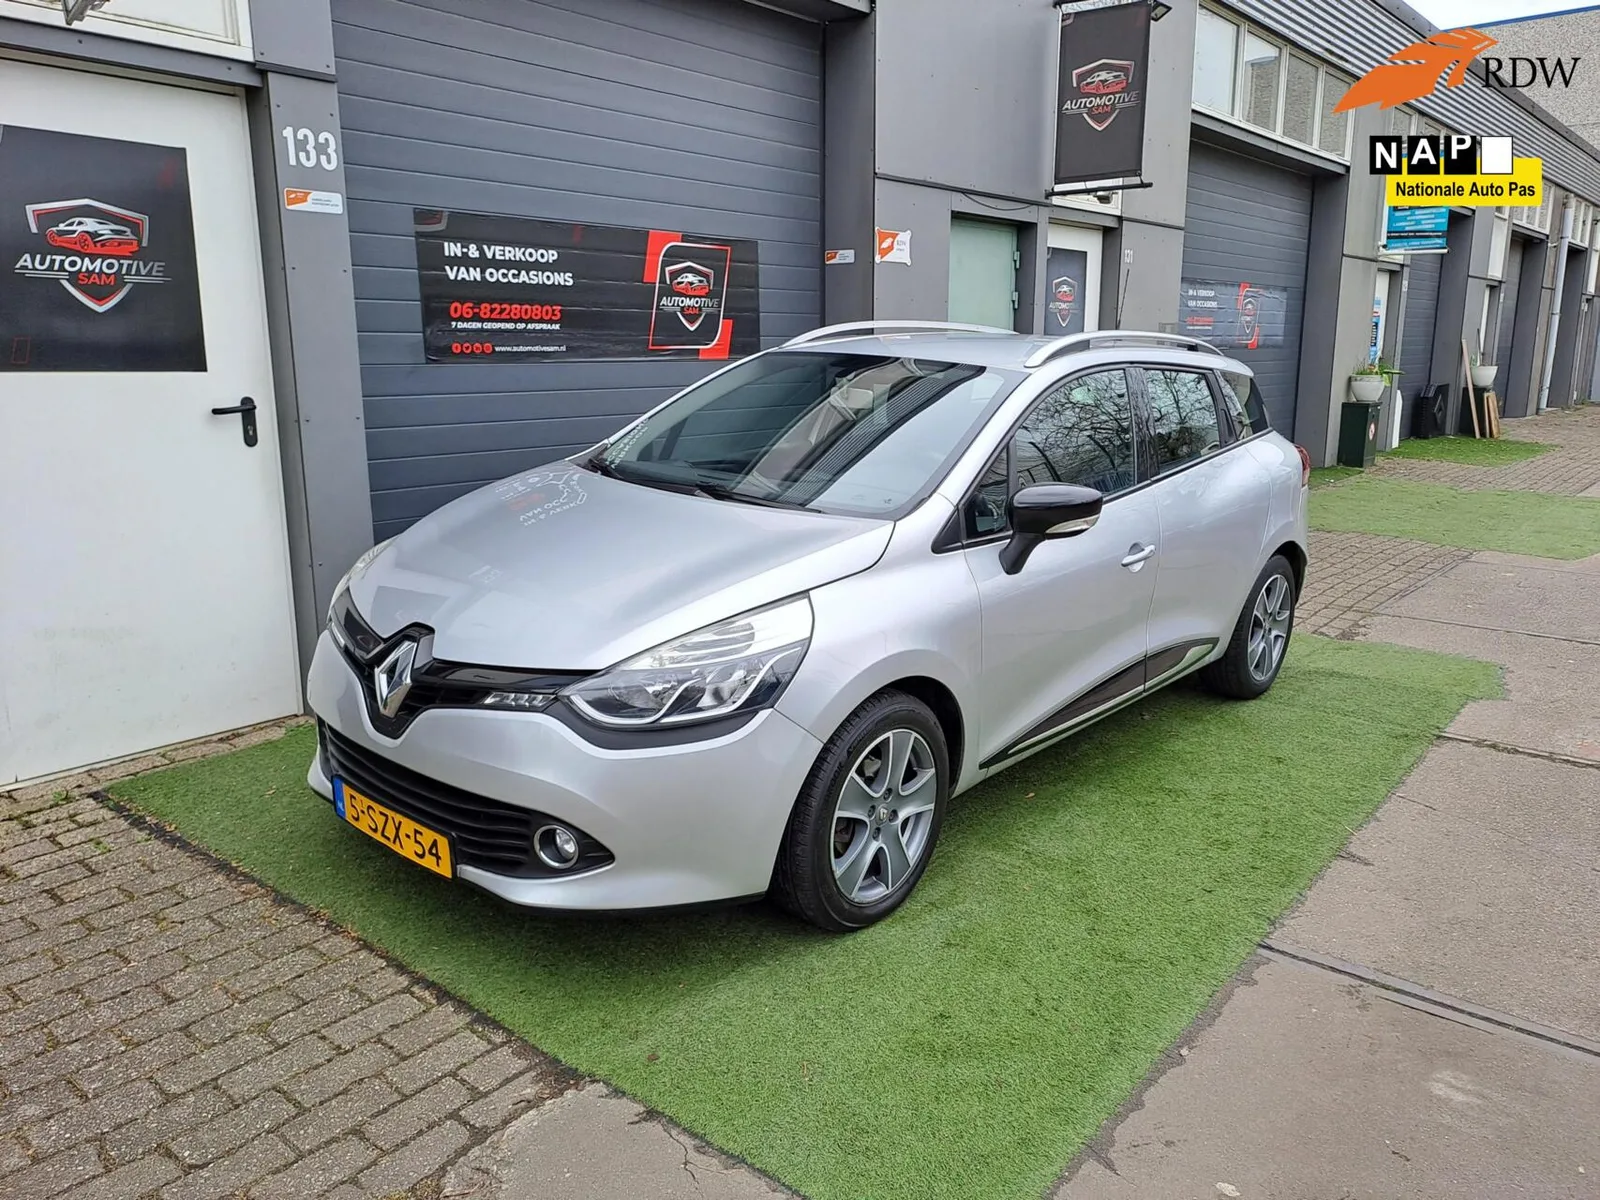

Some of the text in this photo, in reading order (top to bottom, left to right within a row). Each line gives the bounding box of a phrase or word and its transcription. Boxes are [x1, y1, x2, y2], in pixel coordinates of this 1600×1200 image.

[1062, 91, 1140, 111] AUTOMOTIVE
[1091, 105, 1112, 115] SAM
[282, 126, 339, 171] 133
[483, 245, 558, 264] VERKOOP
[14, 253, 166, 276] AUTOMOTIVE
[78, 272, 116, 286] SAM
[445, 266, 574, 286] VAN OCCASIONS
[449, 302, 562, 321] 06-82280803
[659, 296, 720, 309] AUTOMOTIVE
[683, 306, 700, 315] SAM
[451, 321, 456, 329] 7
[457, 322, 482, 330] DAGEN
[483, 322, 515, 330] GEOPEND
[527, 323, 561, 331] AFSPRAAK
[494, 344, 566, 352] www.automotivesam.nl
[349, 793, 442, 868] 5-SZX-54
